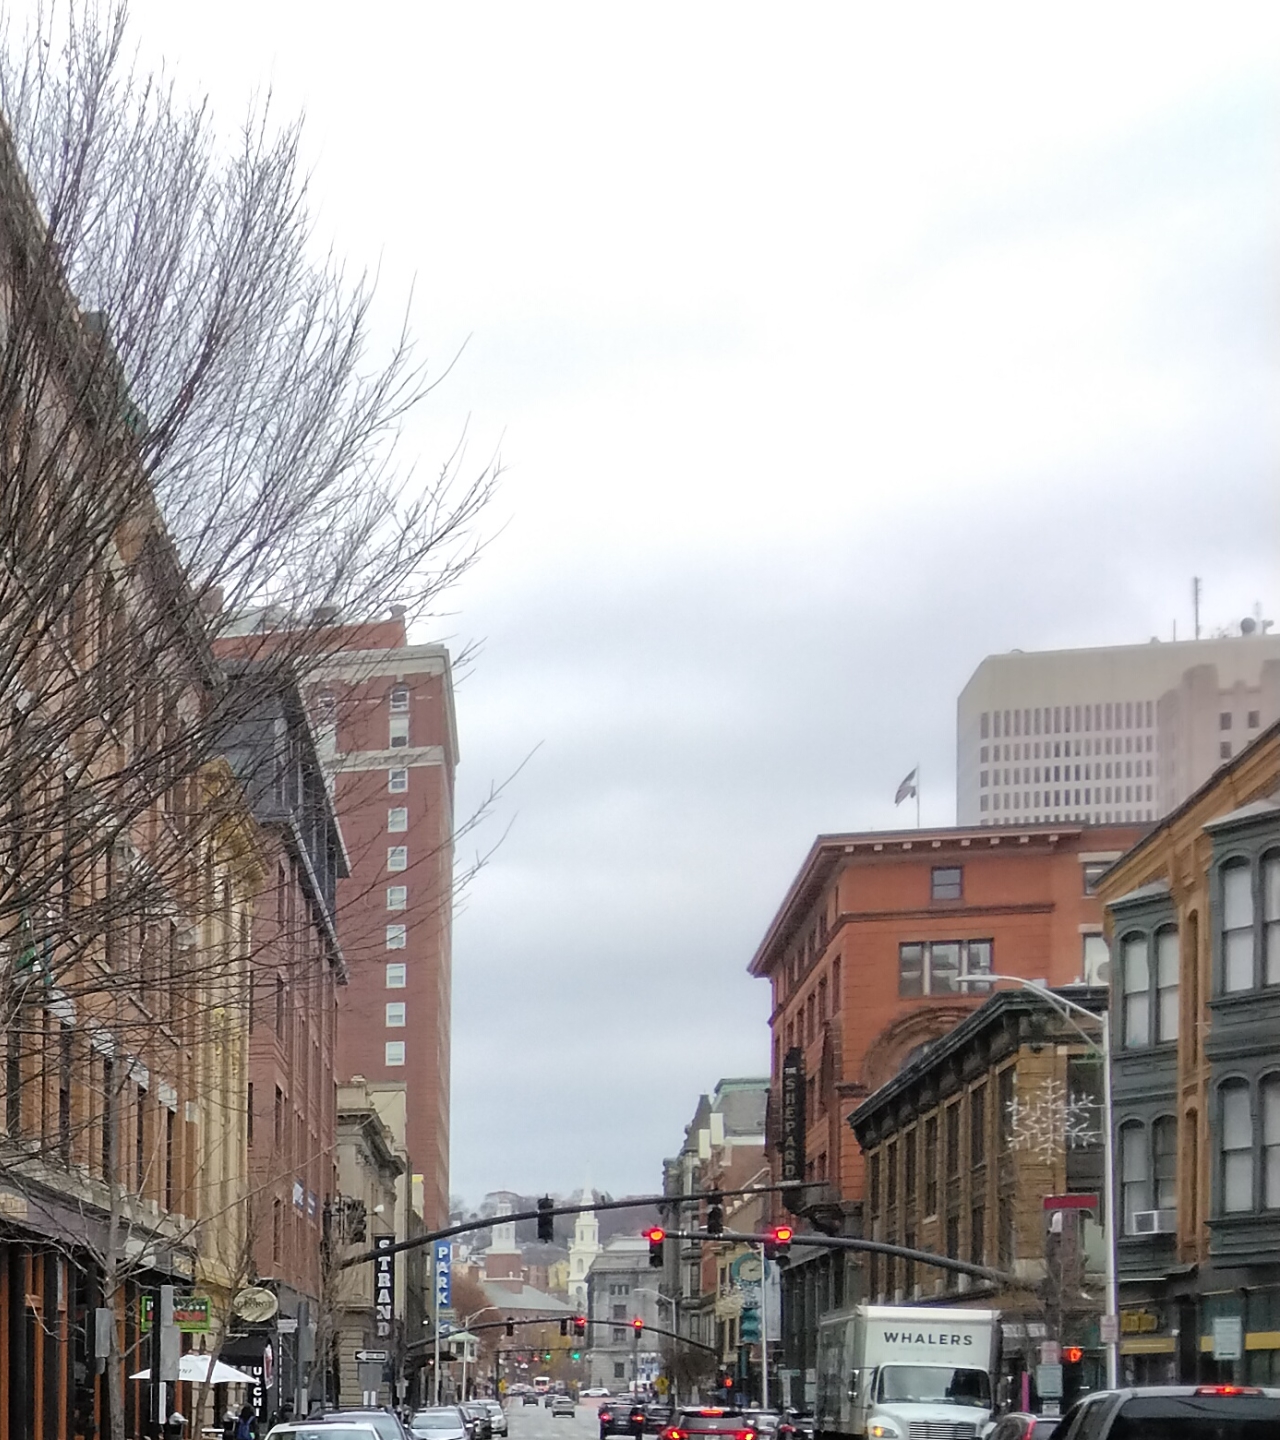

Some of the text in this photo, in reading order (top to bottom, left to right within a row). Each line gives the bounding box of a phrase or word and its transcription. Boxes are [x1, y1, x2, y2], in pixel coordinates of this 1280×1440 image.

[785, 1078, 796, 1176] SHEPARD
[376, 1240, 392, 1336] STRAND
[438, 1247, 449, 1304] PARK
[883, 1332, 973, 1346] WHALERS
